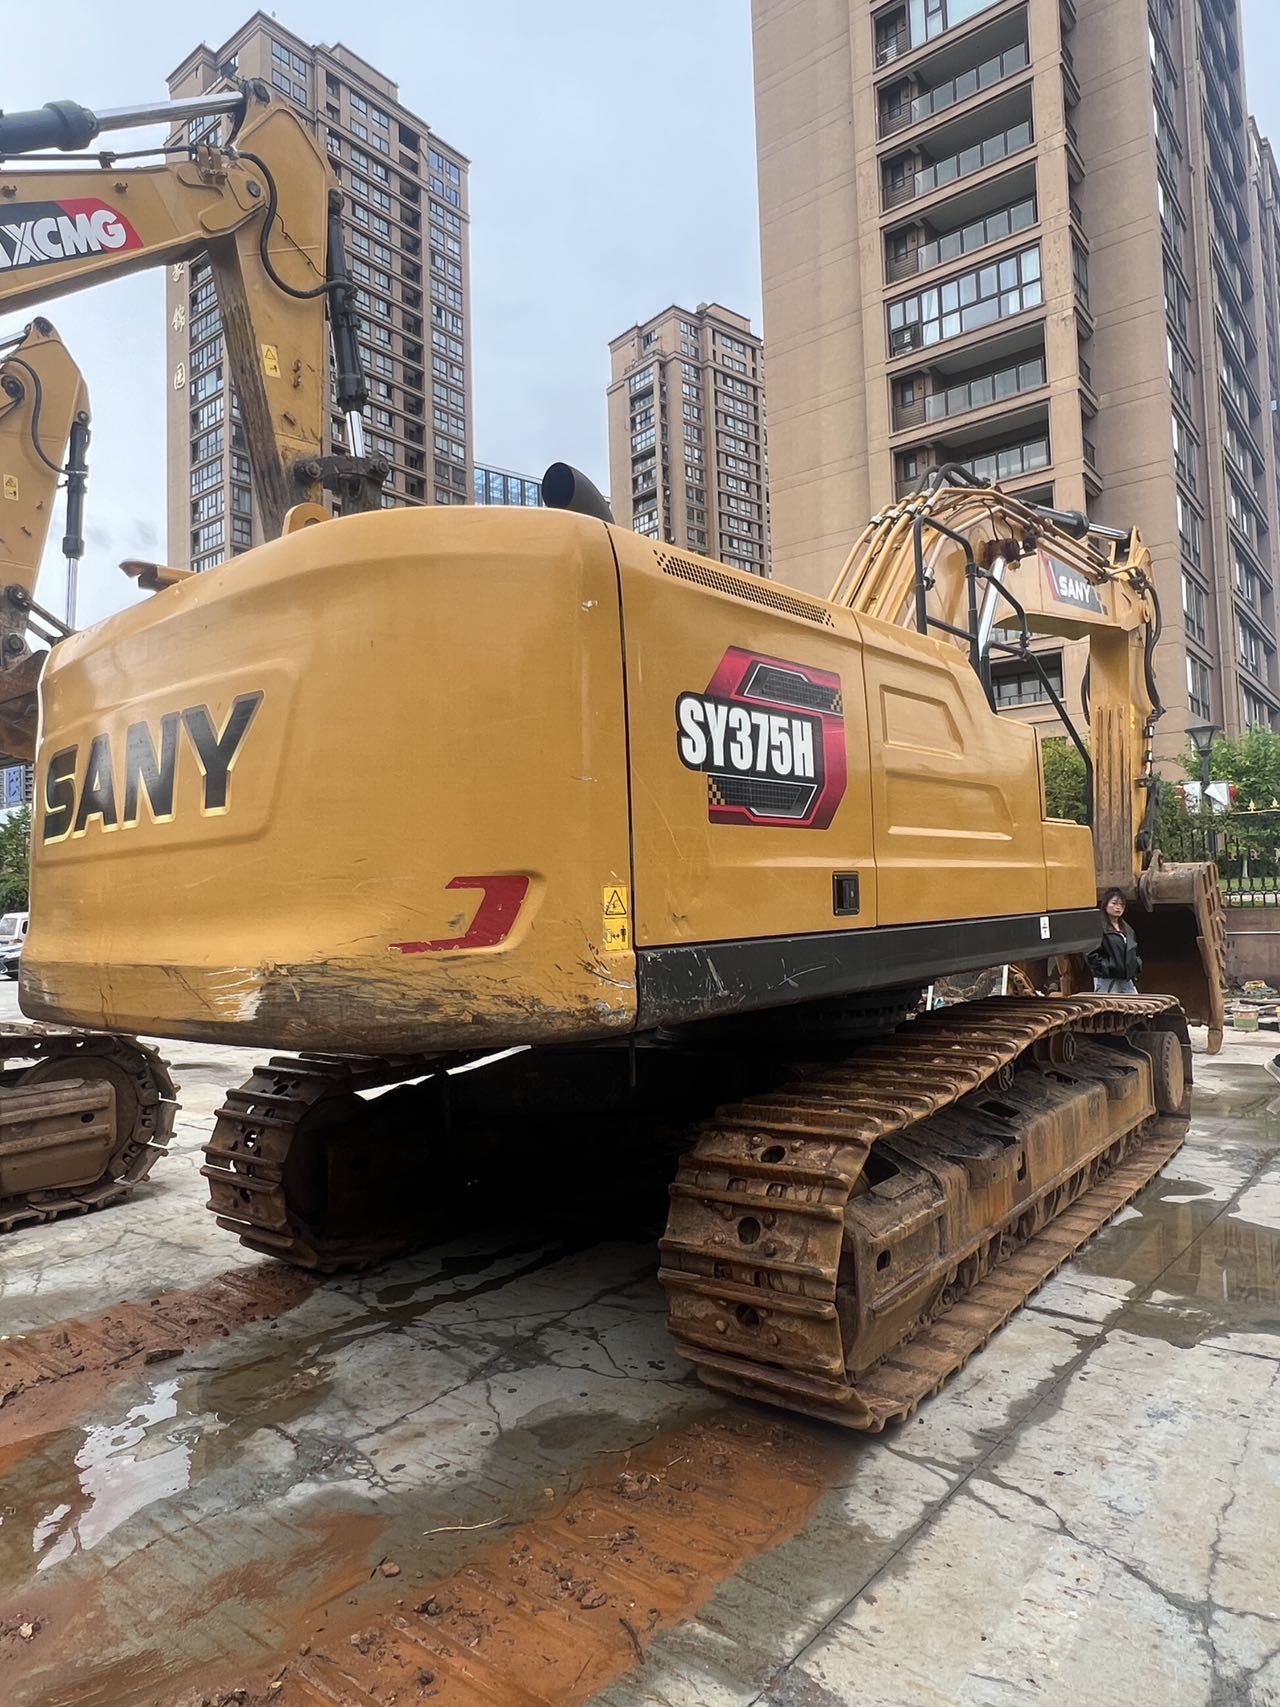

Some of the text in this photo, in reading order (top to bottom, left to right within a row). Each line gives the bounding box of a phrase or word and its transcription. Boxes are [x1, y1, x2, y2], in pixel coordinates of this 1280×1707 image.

[0, 209, 127, 265] XCMG
[1058, 575, 1091, 603] SANY
[43, 690, 264, 846] SANY
[679, 697, 815, 778] SY375H
